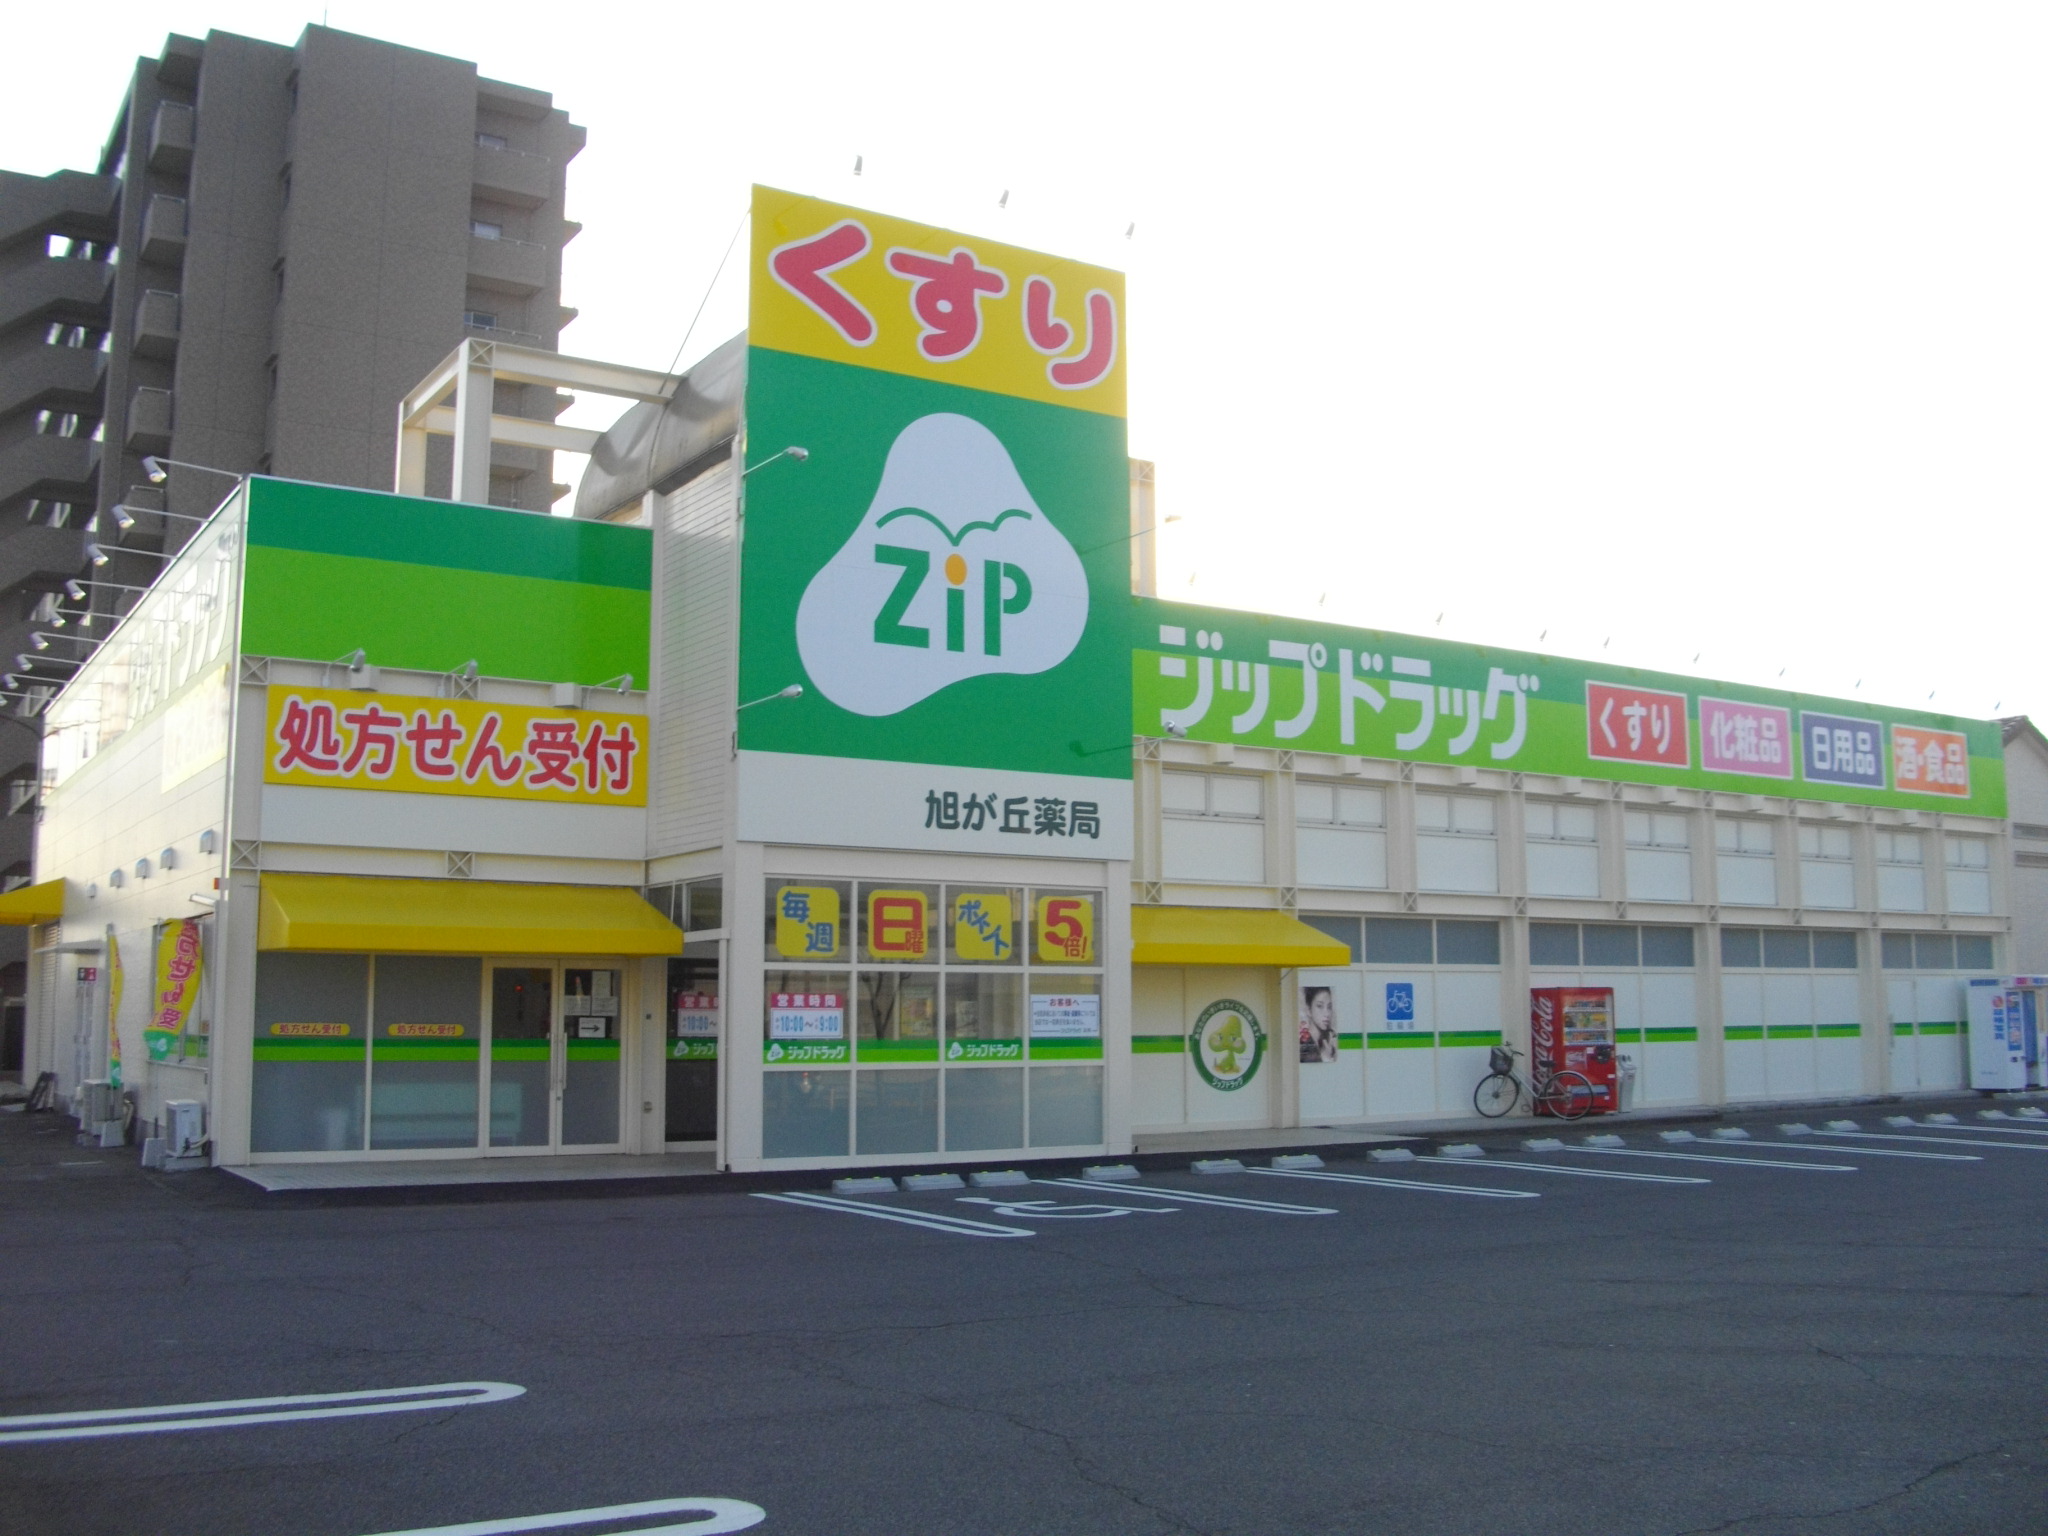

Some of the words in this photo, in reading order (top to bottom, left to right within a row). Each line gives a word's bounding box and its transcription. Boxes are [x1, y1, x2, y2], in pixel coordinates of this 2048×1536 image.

[771, 218, 1118, 392] くすり
[1158, 624, 1539, 760] ジップドラッグ
[277, 698, 637, 791] 処方せん受付
[1597, 698, 1669, 755] くすり
[1709, 716, 1783, 767] 化粧品
[1811, 727, 1875, 777] 日用品
[1895, 736, 1967, 788] 酒・食品
[925, 788, 1101, 839] 旭が丘薬局
[781, 891, 834, 954] 毎週
[873, 897, 924, 954] 日曜
[958, 899, 1010, 957] ポイント
[777, 994, 837, 1007] 営業時間
[279, 1024, 342, 1035] 処方せん受付
[396, 1025, 456, 1035] 処方せん受付
[787, 1045, 846, 1060] ジップドラッグ
[965, 1043, 1020, 1058] ジップドラッグ
